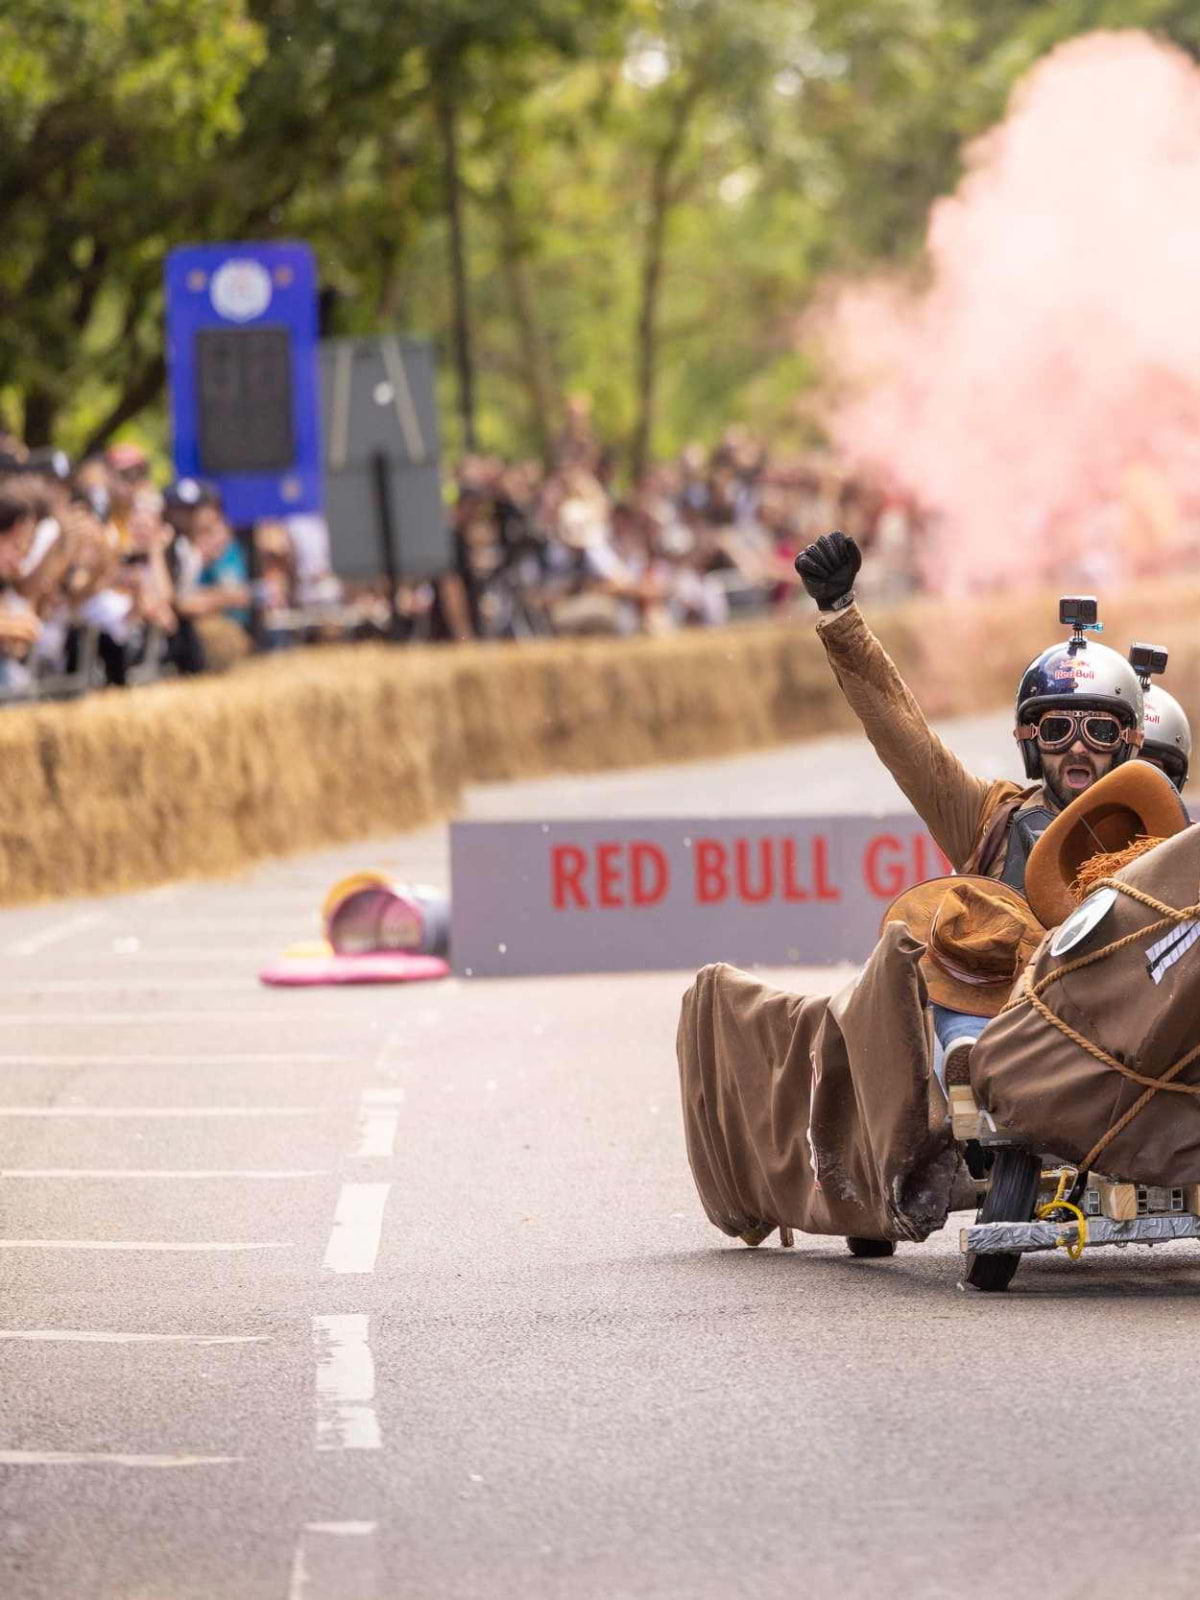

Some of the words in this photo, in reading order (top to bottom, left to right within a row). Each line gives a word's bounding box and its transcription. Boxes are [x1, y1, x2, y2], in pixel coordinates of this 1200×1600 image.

[1055, 670, 1075, 680] Red
[1076, 669, 1095, 680] Bull
[550, 840, 670, 910] RED
[693, 834, 841, 905] BULL
